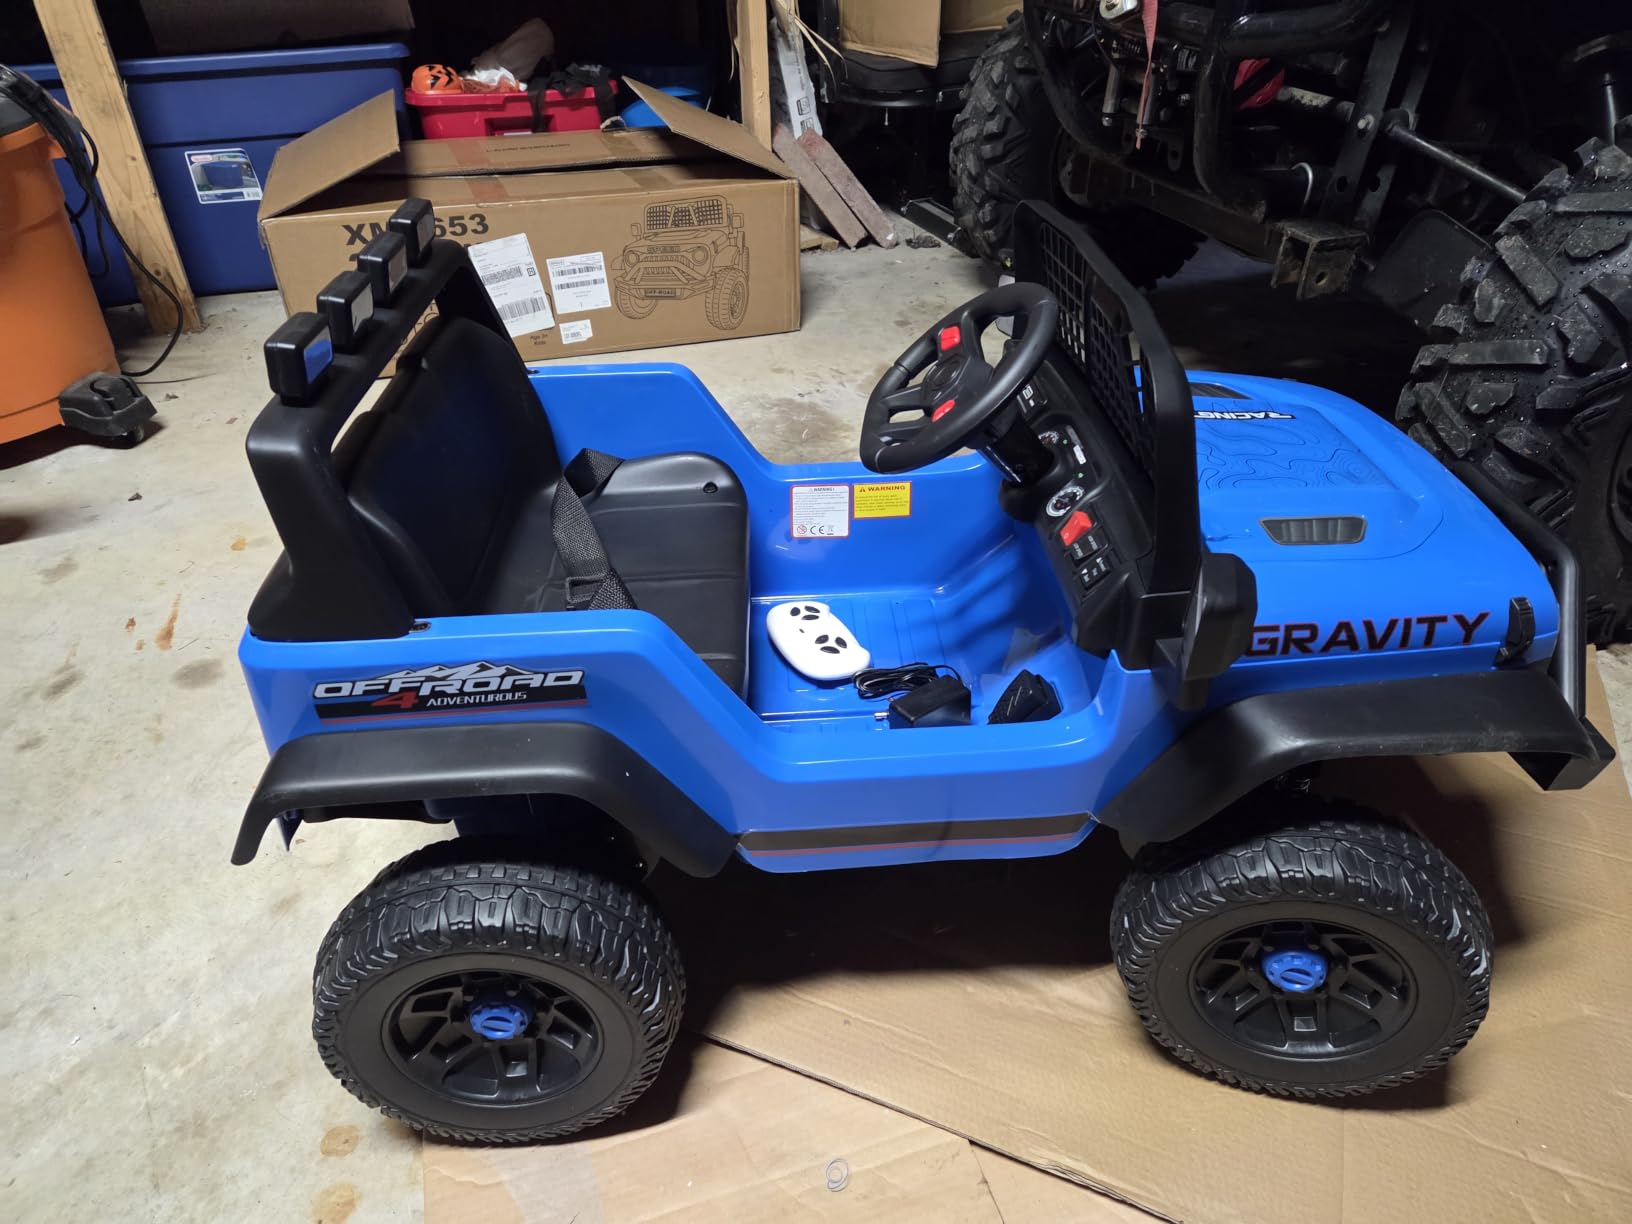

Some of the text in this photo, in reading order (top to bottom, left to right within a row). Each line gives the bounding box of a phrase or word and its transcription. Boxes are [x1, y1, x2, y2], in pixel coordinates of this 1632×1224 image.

[1193, 410, 1293, 419] RACING
[1245, 612, 1490, 657] GRAVITY
[370, 691, 419, 709] 4
[426, 691, 527, 707] ADVENTUROUS
